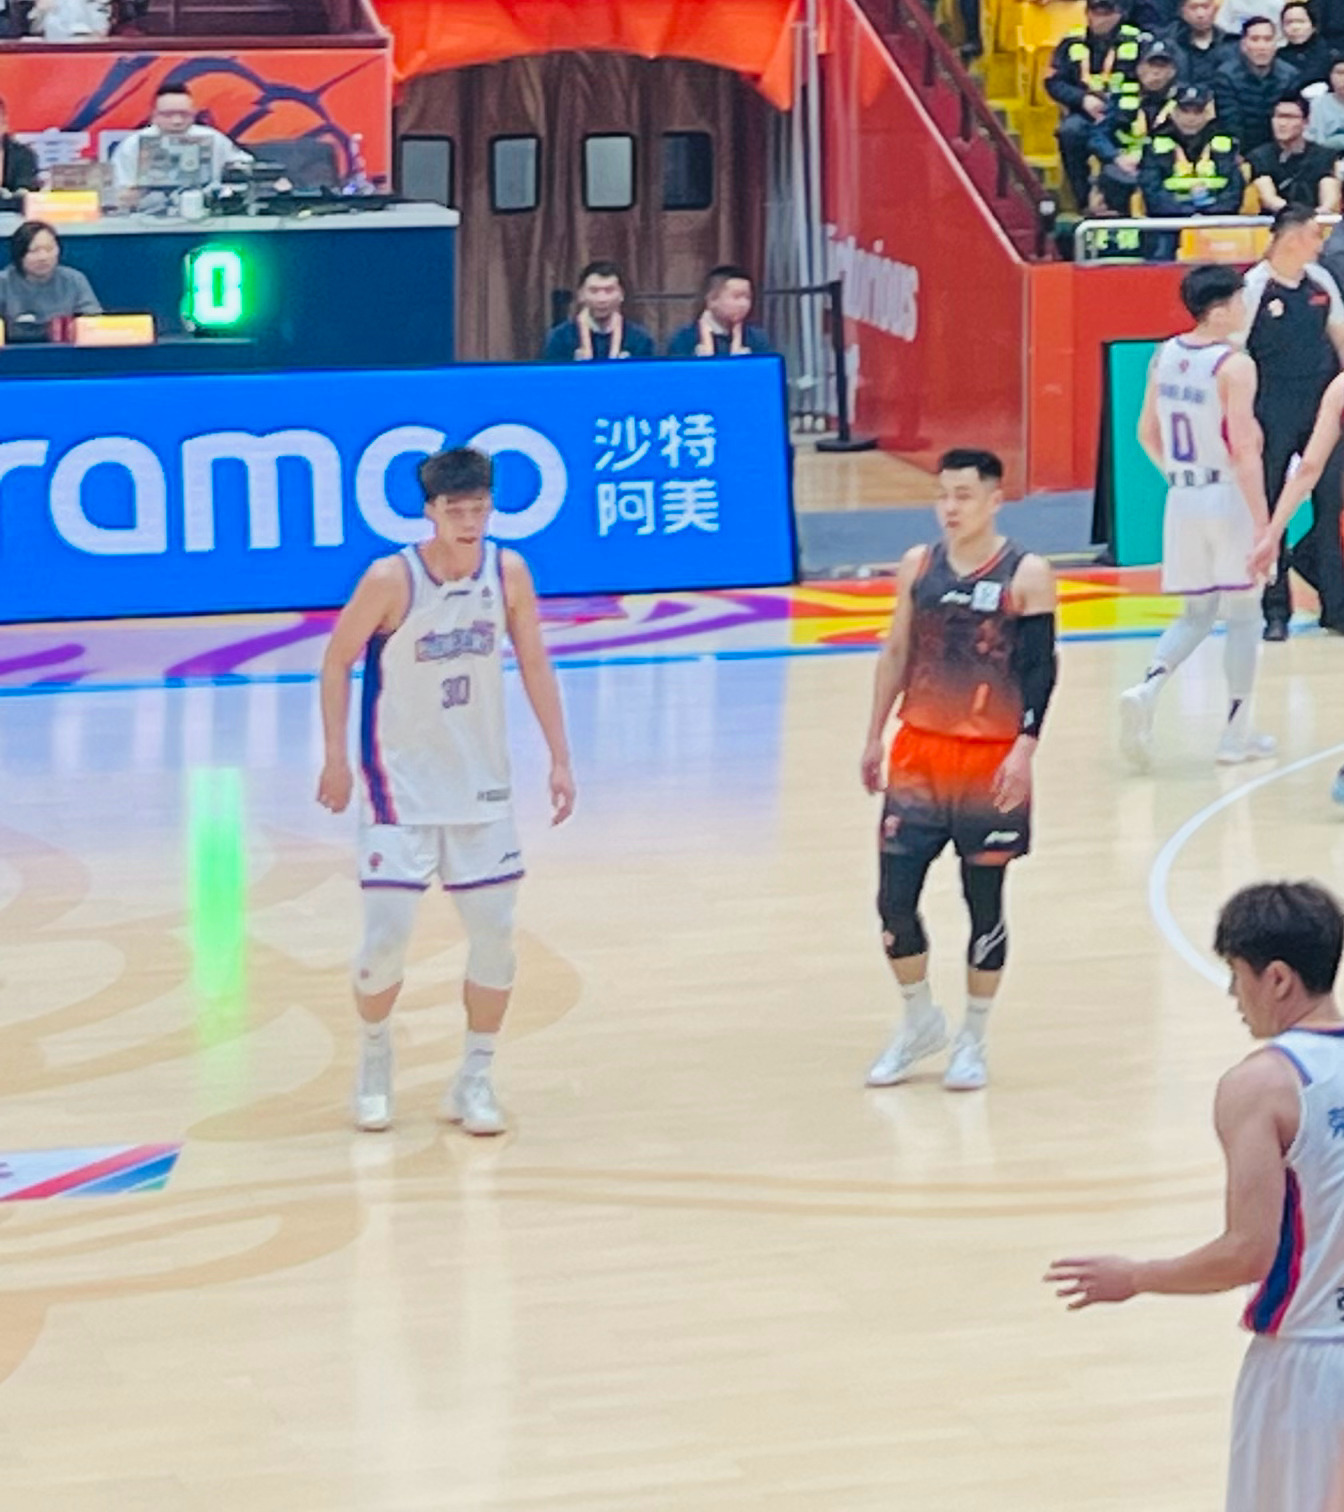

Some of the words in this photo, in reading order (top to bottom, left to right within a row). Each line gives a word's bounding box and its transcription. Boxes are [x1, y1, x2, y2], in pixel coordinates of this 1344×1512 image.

[192, 248, 244, 326] 0
[595, 414, 717, 473] 沙特
[597, 478, 720, 537] 阿美
